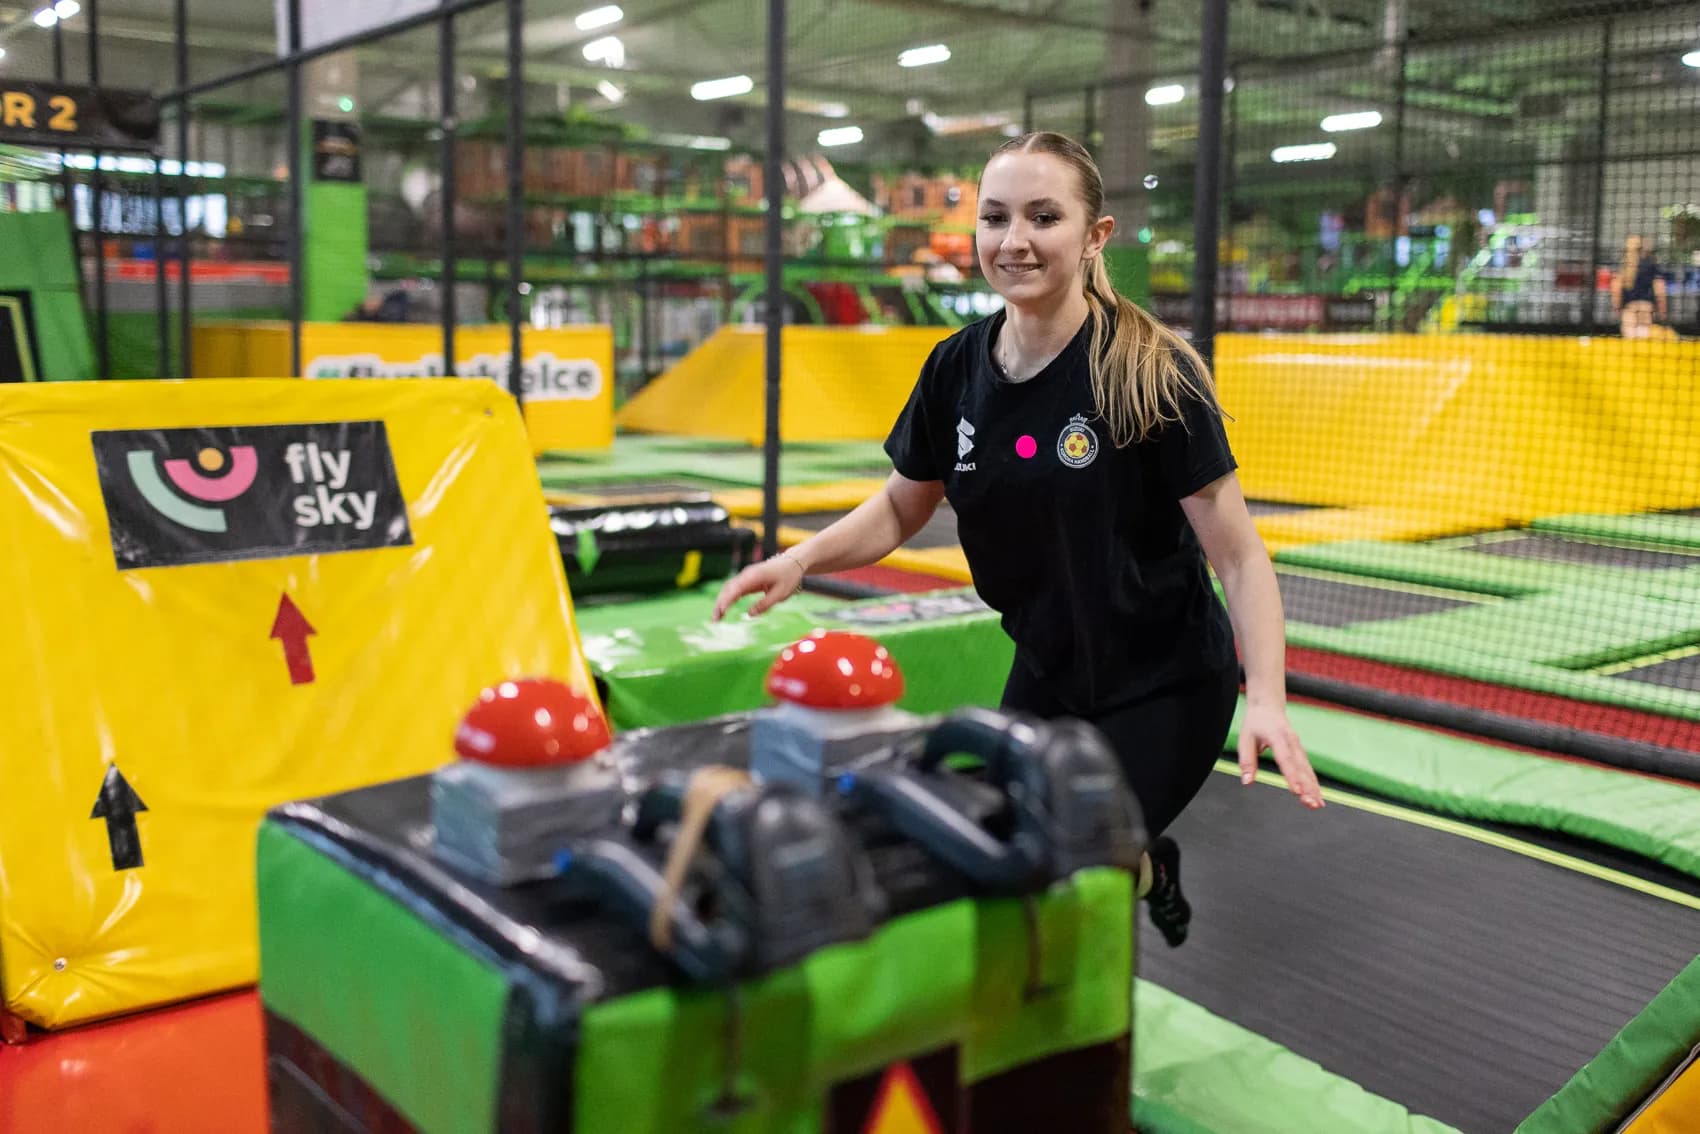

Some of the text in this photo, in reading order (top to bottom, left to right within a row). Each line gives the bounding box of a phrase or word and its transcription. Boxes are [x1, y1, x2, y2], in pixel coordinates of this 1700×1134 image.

[0, 91, 78, 131] R 2
[284, 442, 351, 489] fly
[293, 484, 377, 530] sky
